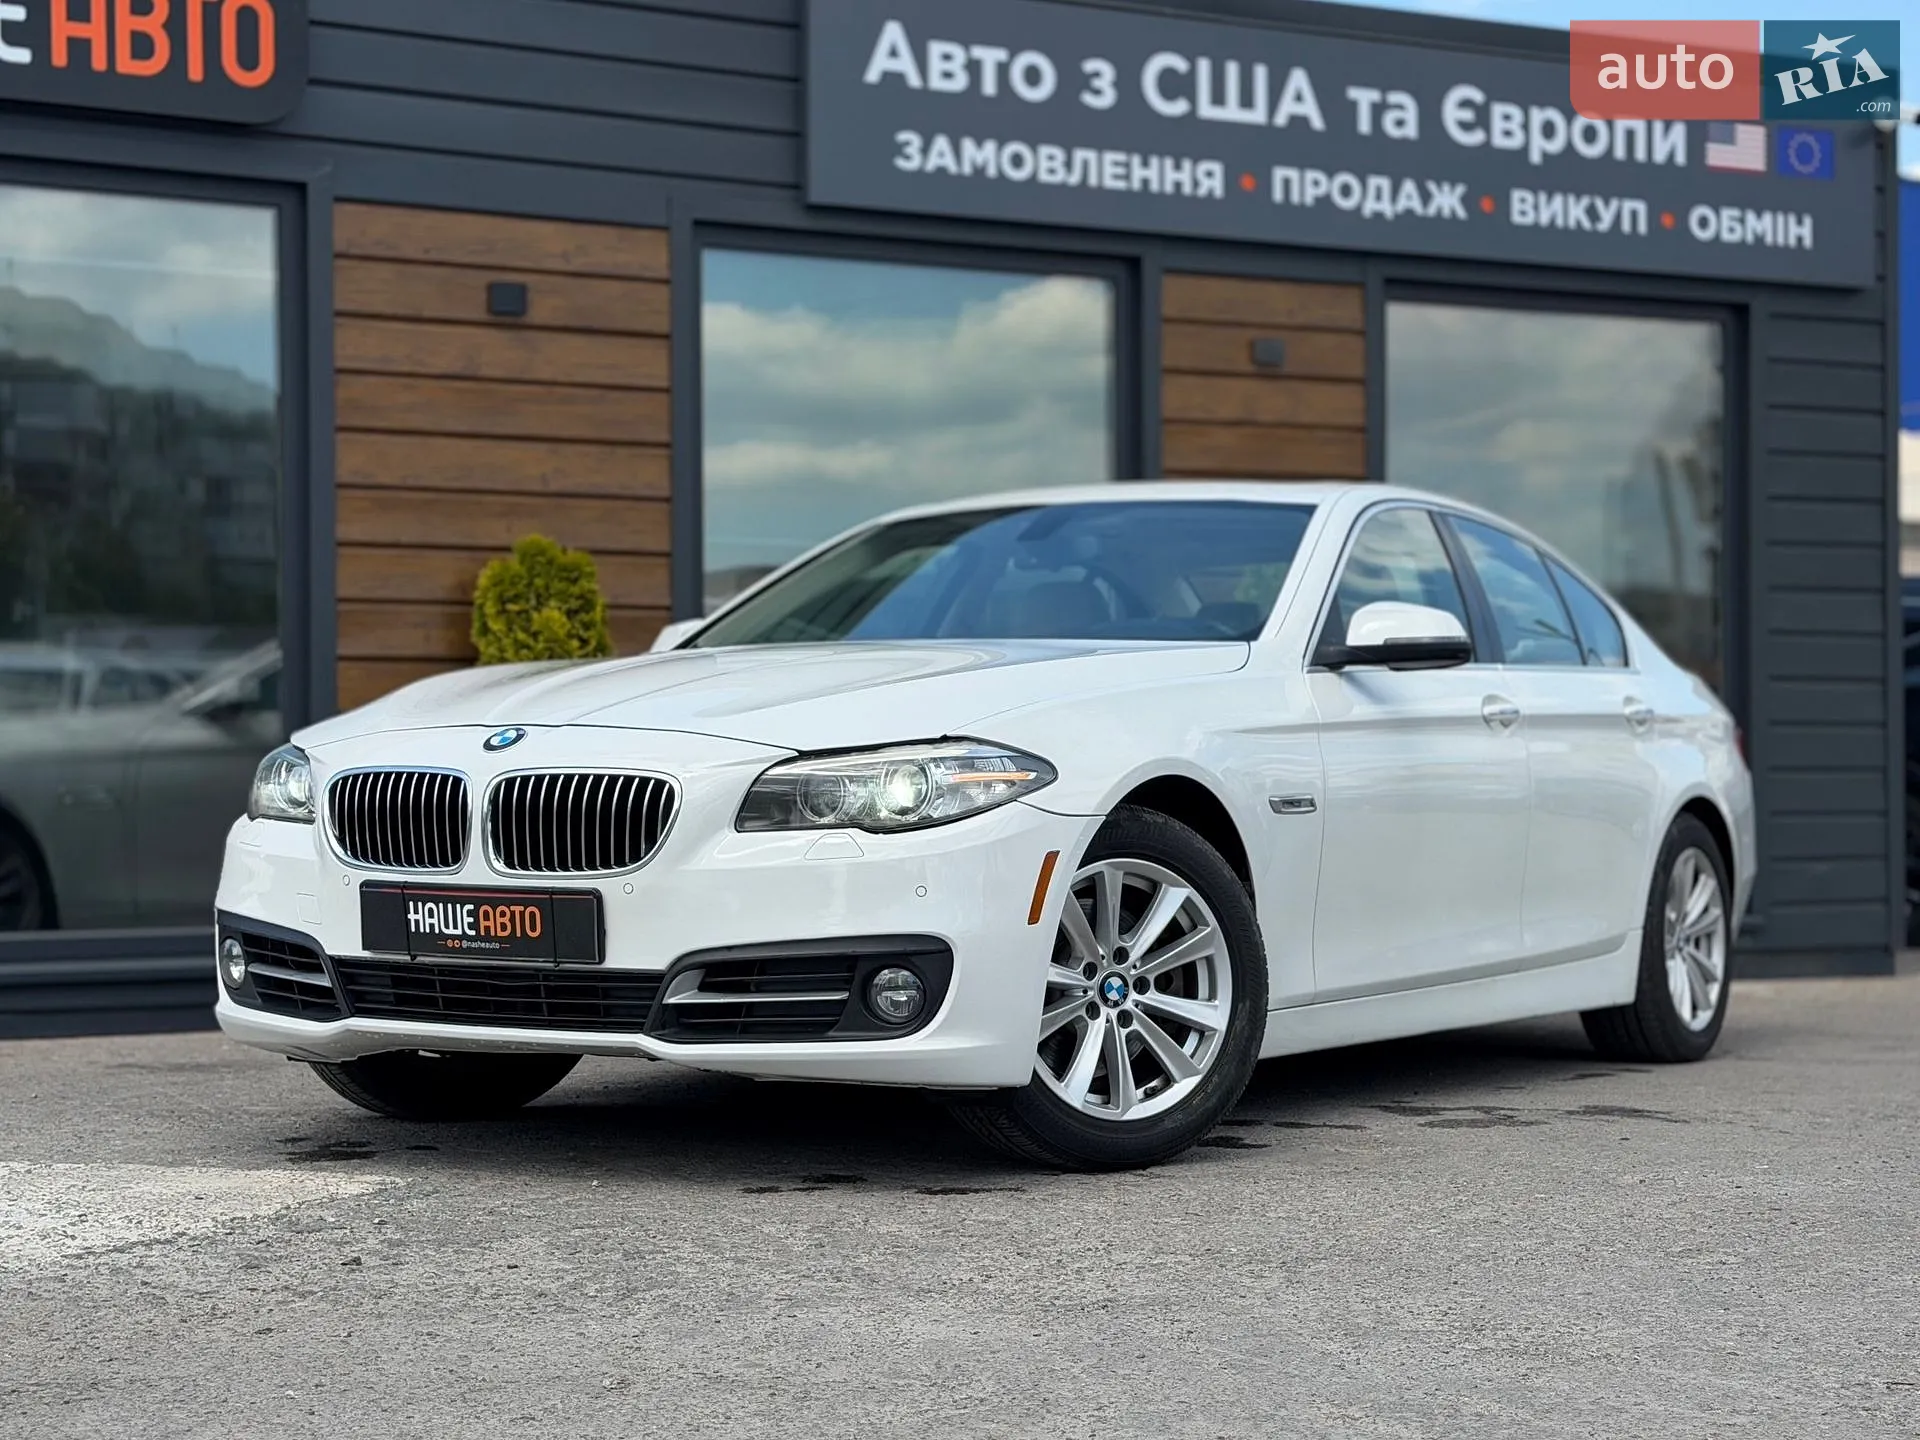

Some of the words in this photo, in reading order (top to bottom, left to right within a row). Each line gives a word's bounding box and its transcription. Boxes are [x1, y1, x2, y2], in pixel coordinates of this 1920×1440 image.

[50, 0, 276, 88] АВТО
[864, 20, 1057, 102] Авто
[1141, 52, 1325, 131] США
[1346, 85, 1419, 139] та
[1442, 84, 1687, 166] Європи
[894, 130, 1224, 199] ЗАМОВЛЕННЯ
[1272, 166, 1467, 219] ПРОДАЖ
[1509, 188, 1648, 236] ВИКУП
[1688, 205, 1813, 249] ОБМІН
[407, 901, 476, 935] НАШЕ
[478, 904, 541, 937] АВТО
[461, 940, 500, 949] @nasheauto
